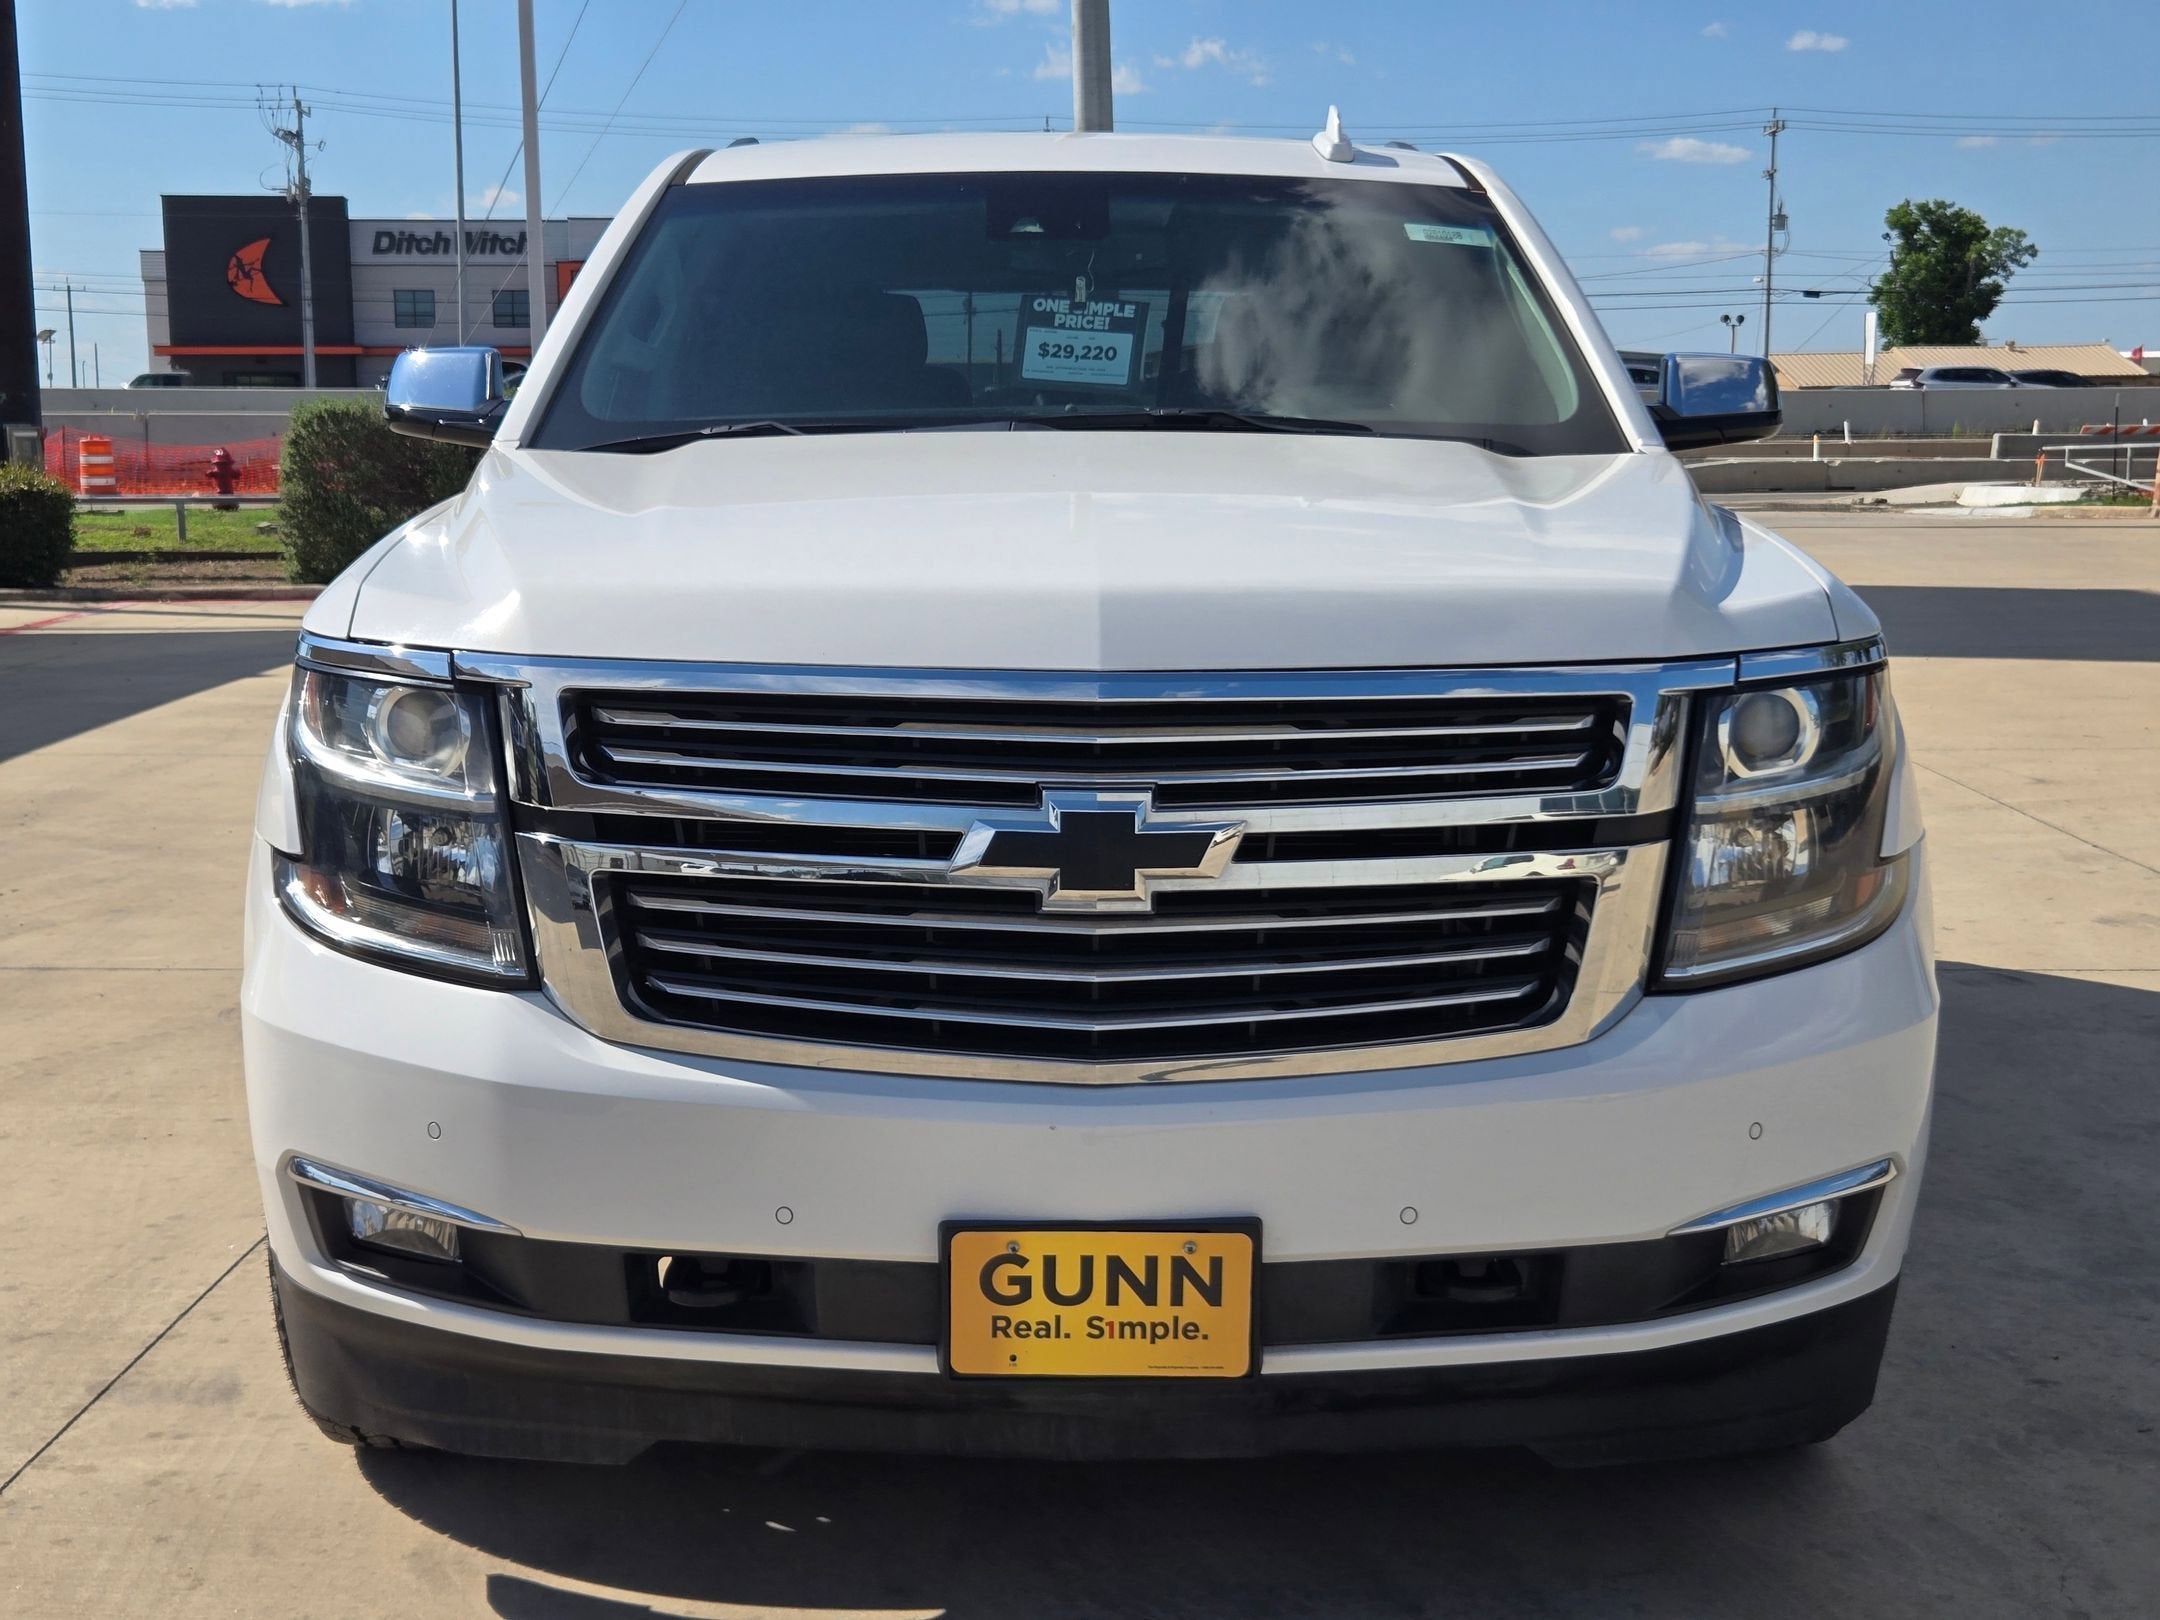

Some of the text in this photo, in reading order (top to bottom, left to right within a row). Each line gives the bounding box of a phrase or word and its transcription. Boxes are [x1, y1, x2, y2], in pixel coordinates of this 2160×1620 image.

[372, 231, 451, 255] Ditch
[1033, 298, 1136, 318] ONE IMPLE
[1054, 313, 1110, 330] PRICE!
[1038, 341, 1118, 362] $29,220
[979, 1253, 1223, 1307] GUNN
[991, 1315, 1071, 1339] Real.
